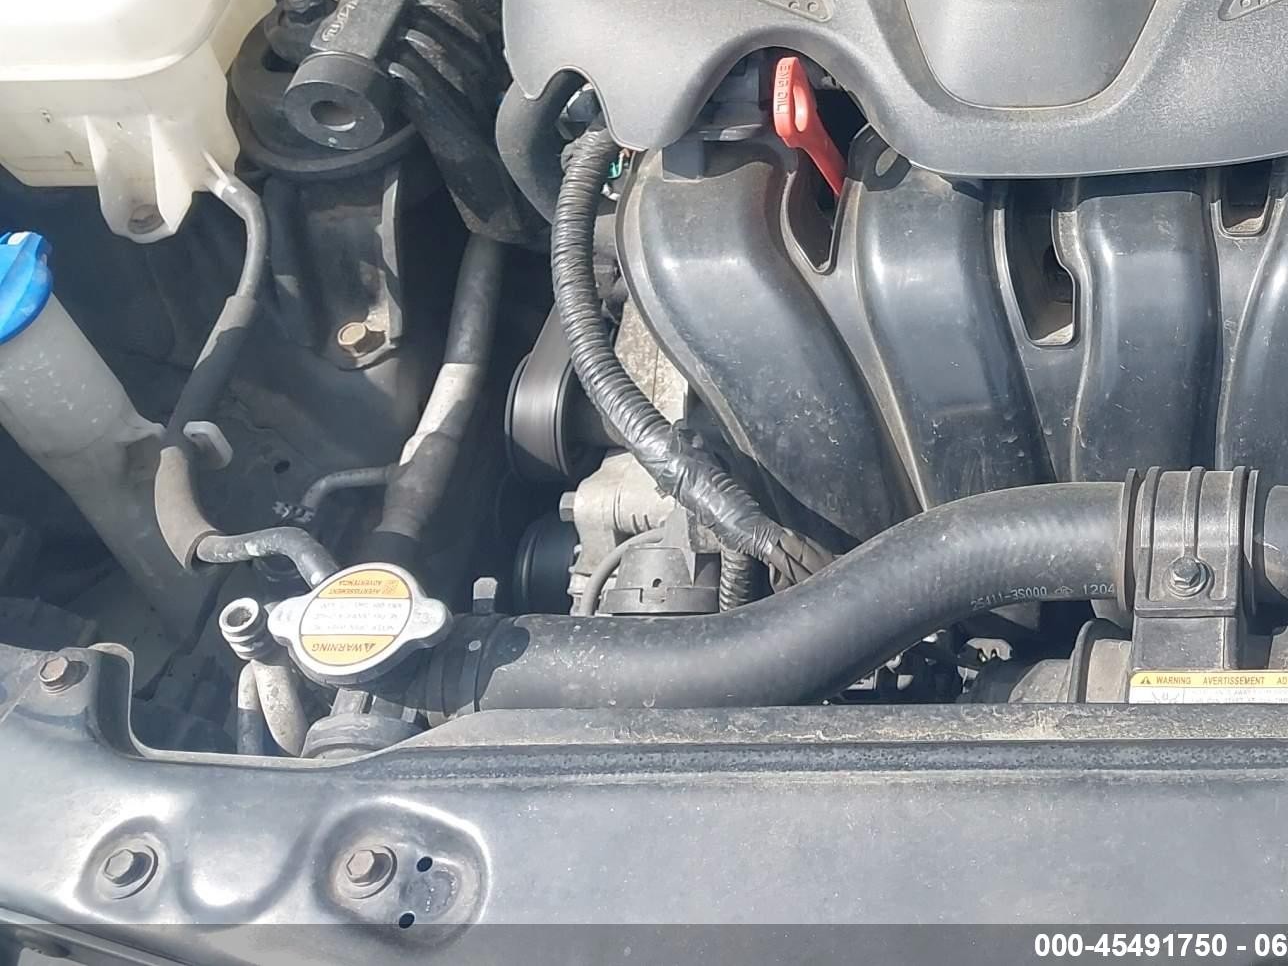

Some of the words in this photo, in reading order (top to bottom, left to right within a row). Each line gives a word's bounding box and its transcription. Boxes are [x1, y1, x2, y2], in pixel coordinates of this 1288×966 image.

[1082, 583, 1116, 596] 1204
[311, 642, 365, 652] WARNING
[1156, 675, 1192, 685] WARNING
[1202, 675, 1265, 685] AVERTISSEMENT
